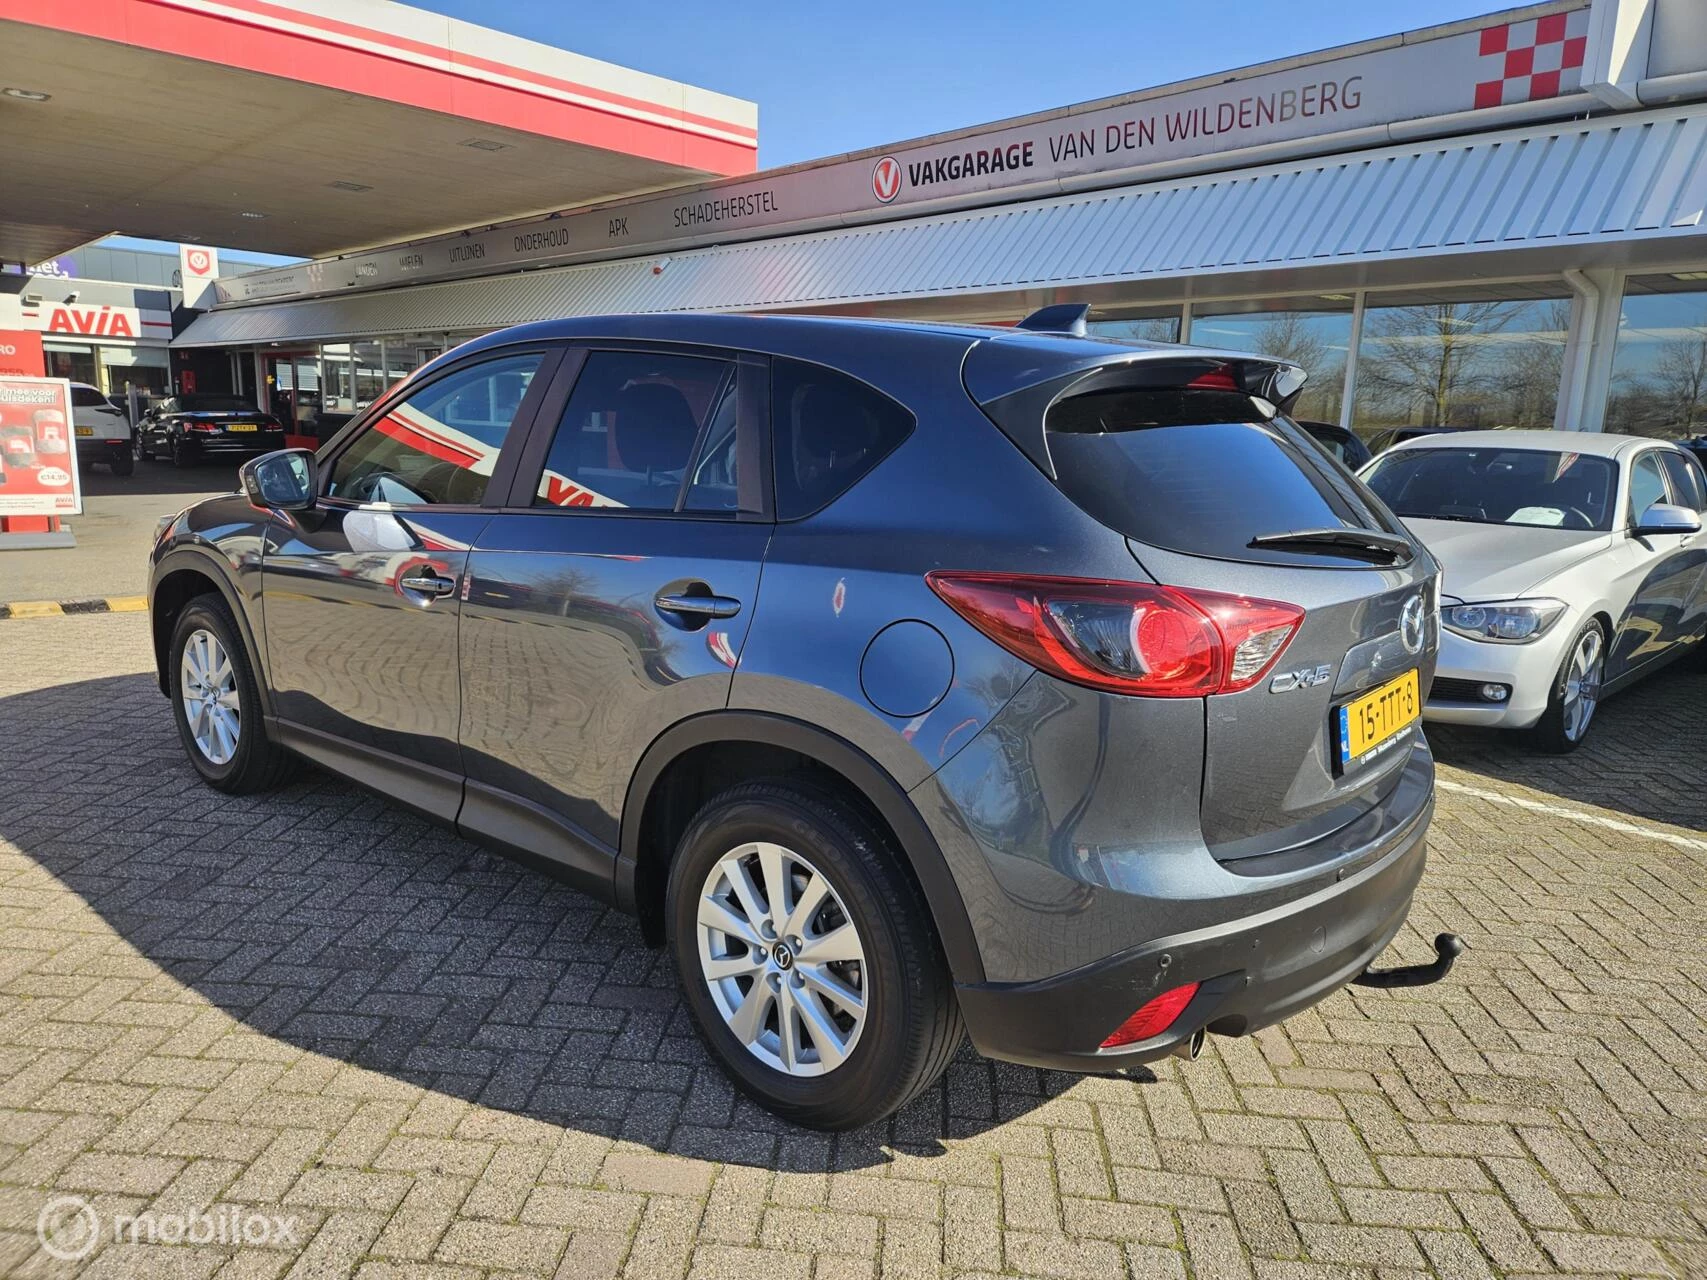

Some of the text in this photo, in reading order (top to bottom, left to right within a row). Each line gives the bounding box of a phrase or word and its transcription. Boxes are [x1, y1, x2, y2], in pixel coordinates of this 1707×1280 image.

[908, 141, 1034, 187] VAKGARAGE
[1049, 129, 1095, 162] VAN
[1105, 117, 1156, 153] DEN
[1165, 76, 1363, 142] WILDENBERG
[673, 191, 778, 227] SCHADEHERSTEL
[514, 228, 569, 252] ONDERHOUD
[608, 217, 629, 238] APK
[48, 306, 133, 336] AVIA
[1269, 664, 1331, 694] CX-5
[1360, 681, 1413, 744] 15-TTT-8
